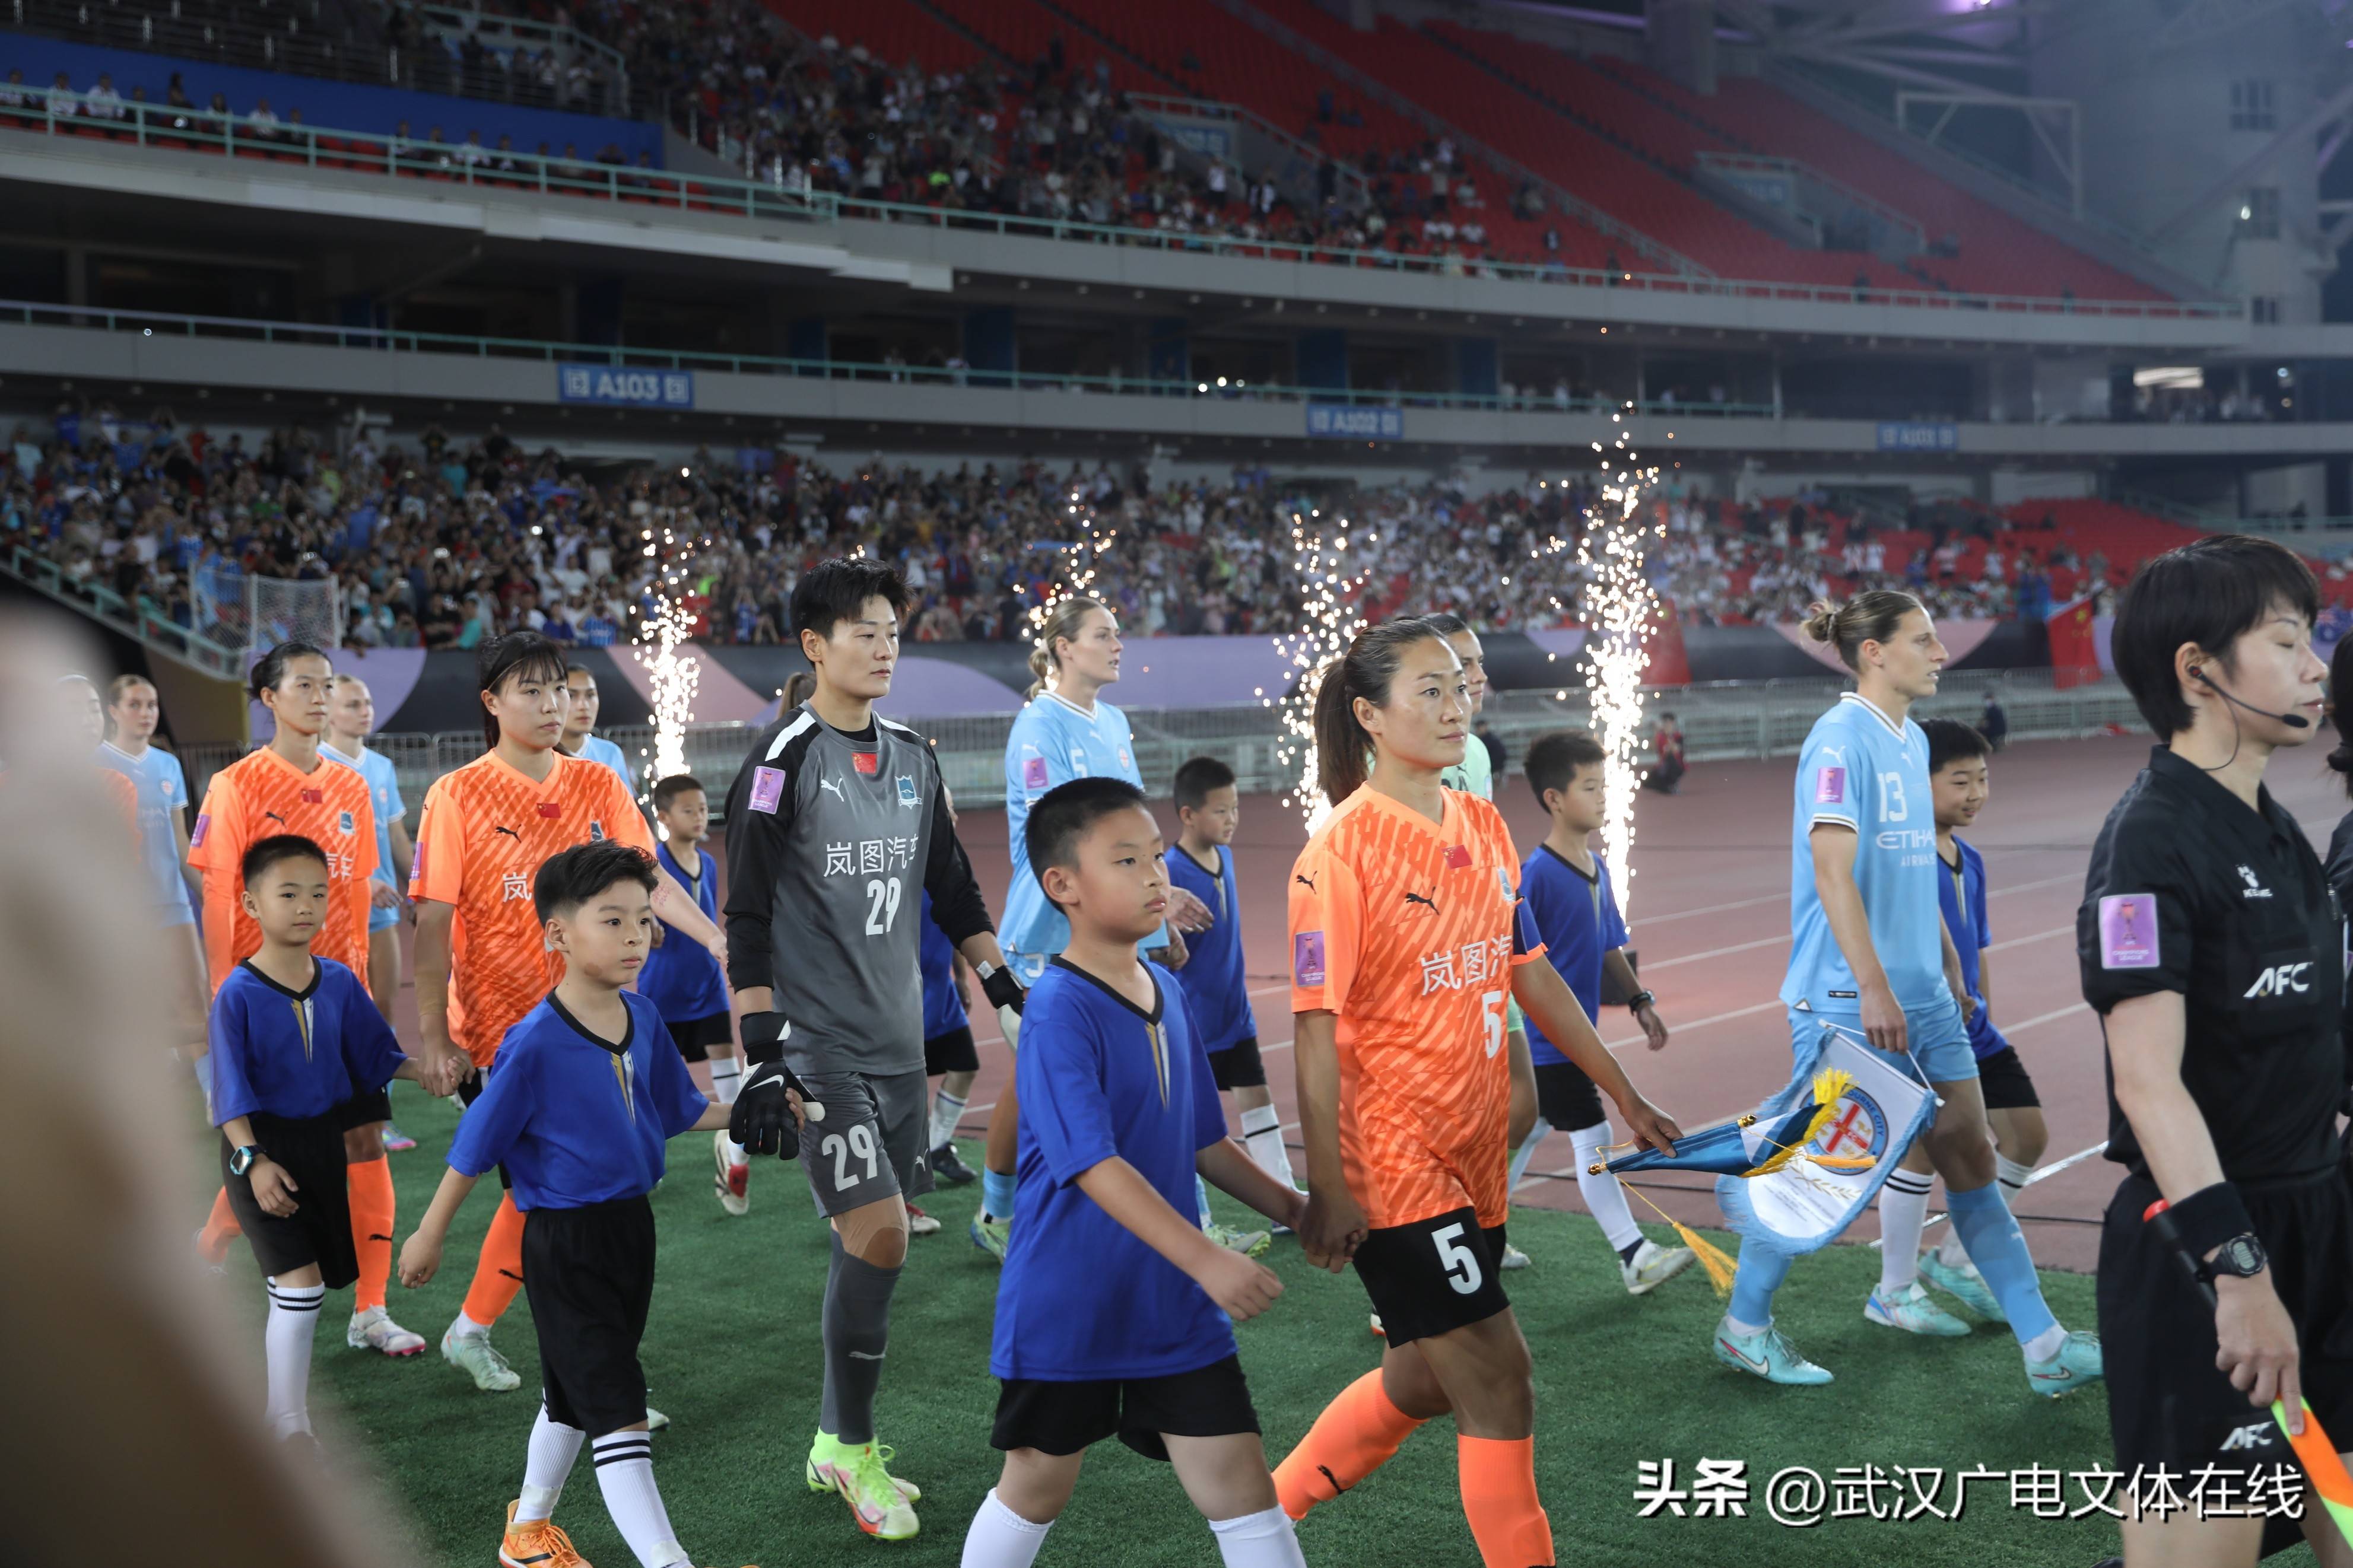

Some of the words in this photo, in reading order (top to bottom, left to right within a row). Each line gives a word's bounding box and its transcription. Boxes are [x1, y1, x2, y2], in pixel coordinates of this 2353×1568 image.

[596, 371, 660, 400] A103
[1877, 772, 1908, 822] 13
[1876, 828, 1936, 849] ETIHA
[866, 877, 901, 936] 29
[1420, 934, 1511, 995] 岚图汽
[2243, 962, 2311, 994] AFC
[1482, 990, 1502, 1058] 5
[822, 1124, 878, 1192] 29
[1431, 1222, 1482, 1294] 5
[2219, 1421, 2273, 1450] AFC
